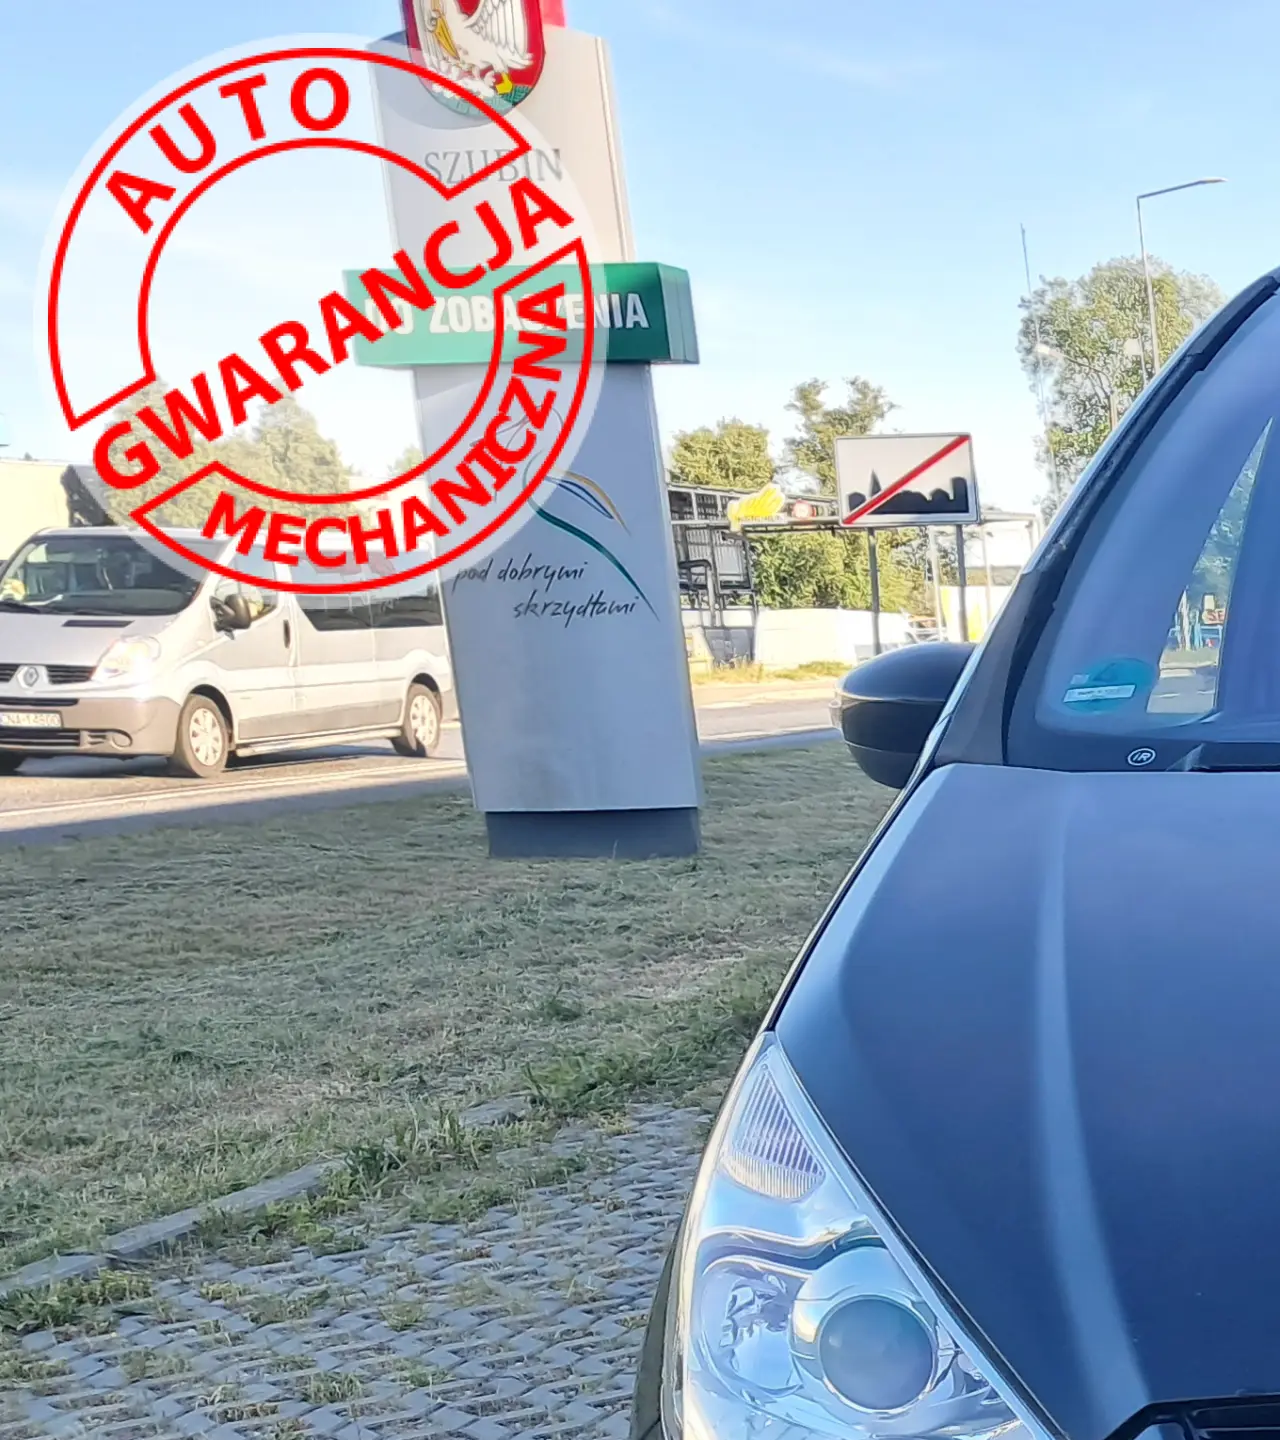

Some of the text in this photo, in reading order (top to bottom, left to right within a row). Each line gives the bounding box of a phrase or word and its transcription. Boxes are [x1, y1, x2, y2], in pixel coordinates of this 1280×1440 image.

[424, 148, 562, 185] SZUBIN
[452, 553, 588, 596] pod dobrymi
[513, 589, 640, 628] skrzydłami
